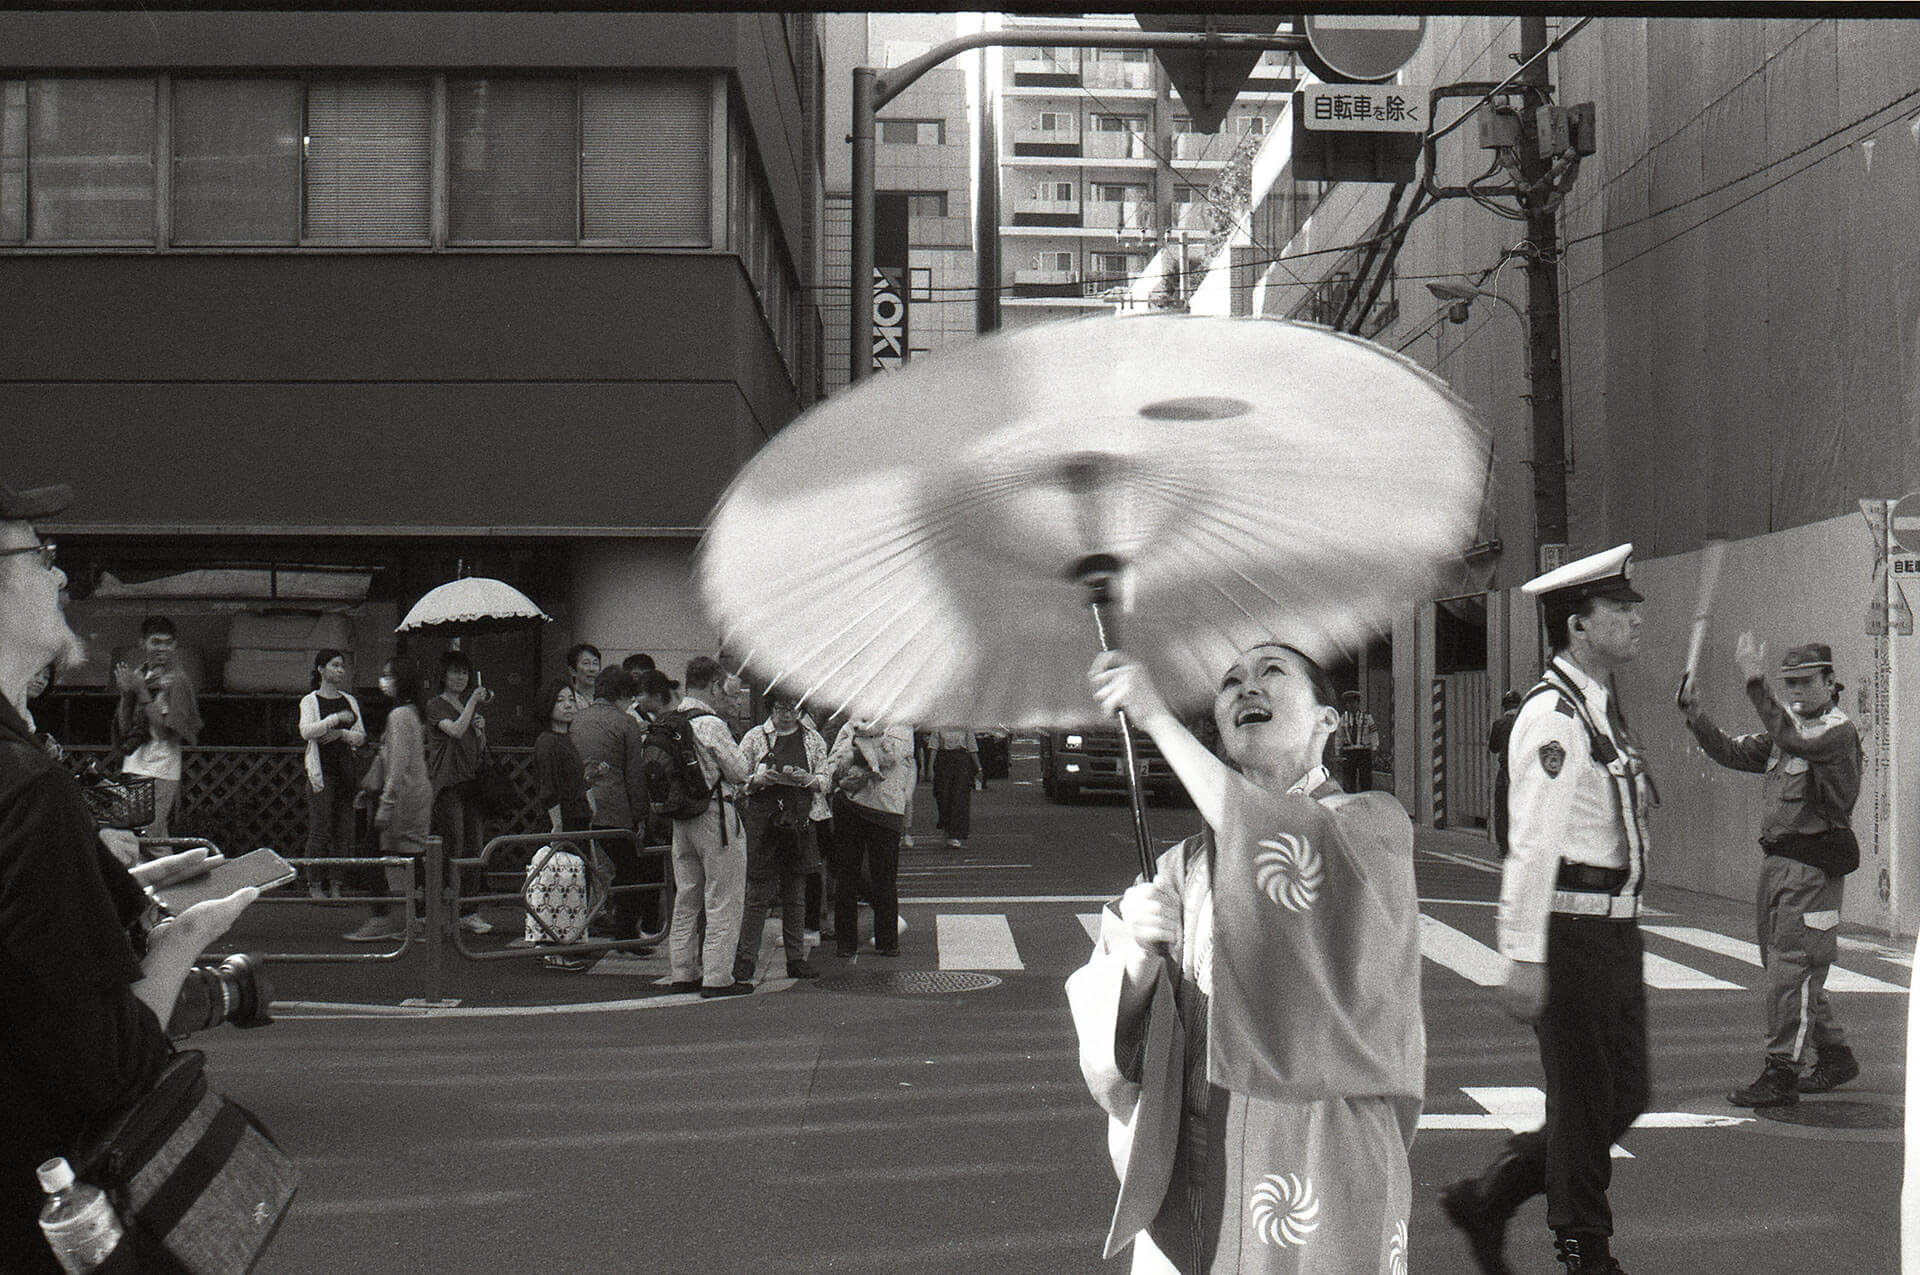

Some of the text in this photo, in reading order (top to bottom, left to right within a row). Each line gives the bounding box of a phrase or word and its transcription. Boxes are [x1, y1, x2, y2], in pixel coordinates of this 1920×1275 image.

[1315, 94, 1418, 121] 自転車を除く
